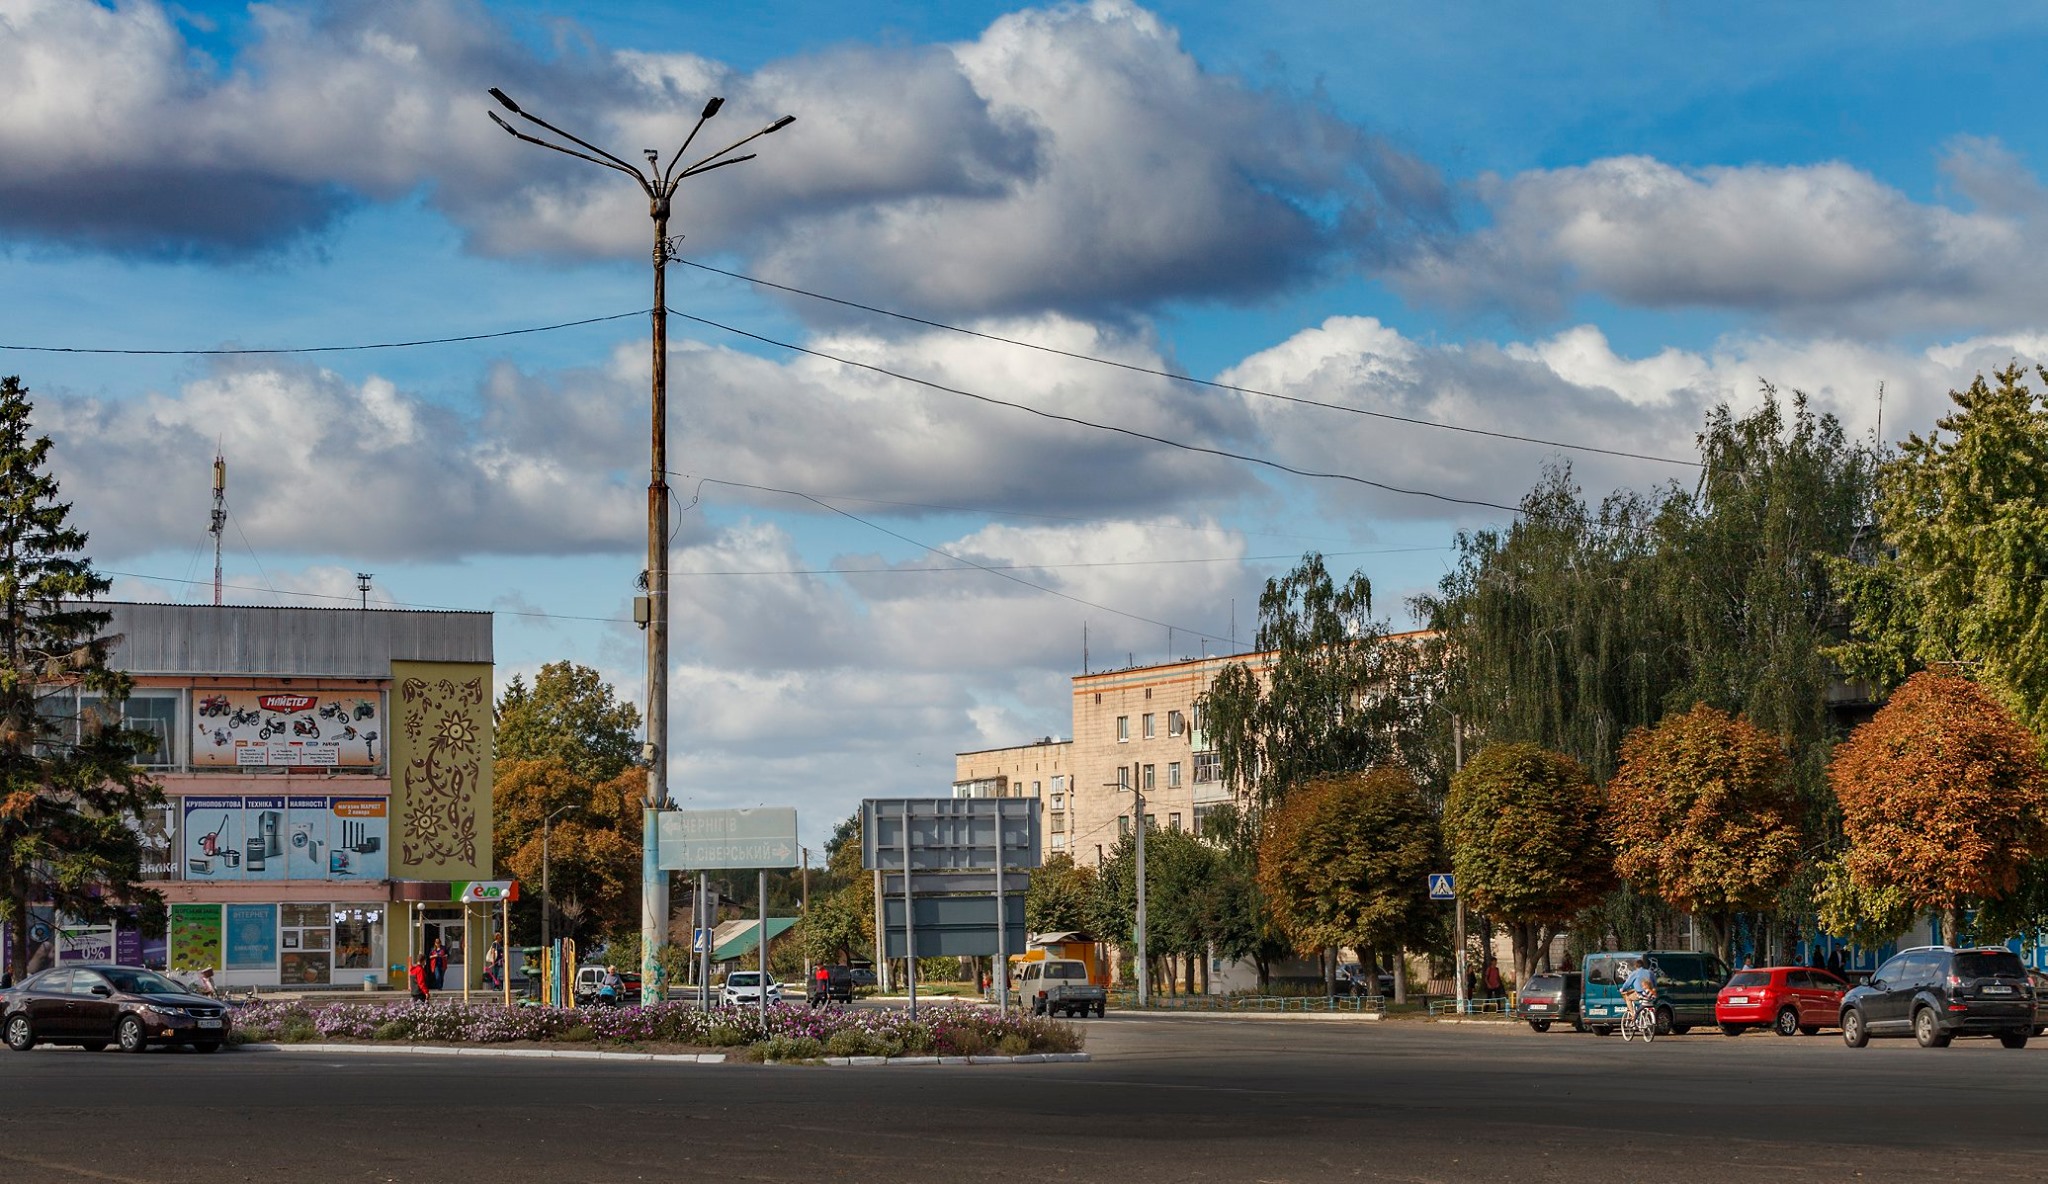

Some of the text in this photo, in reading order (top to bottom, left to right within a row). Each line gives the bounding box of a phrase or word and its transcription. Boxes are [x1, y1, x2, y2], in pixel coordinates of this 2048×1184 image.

[266, 695, 309, 707] МАЙСТЕР
[186, 800, 242, 808] КРУПНОПОБУТОВА
[247, 800, 273, 808] ТЕХНІКА
[277, 800, 282, 808] В
[289, 800, 323, 808] НАЯВНОСТІ
[697, 840, 771, 862] СІВЕРСЬКИЙ
[81, 946, 106, 961] 0%
